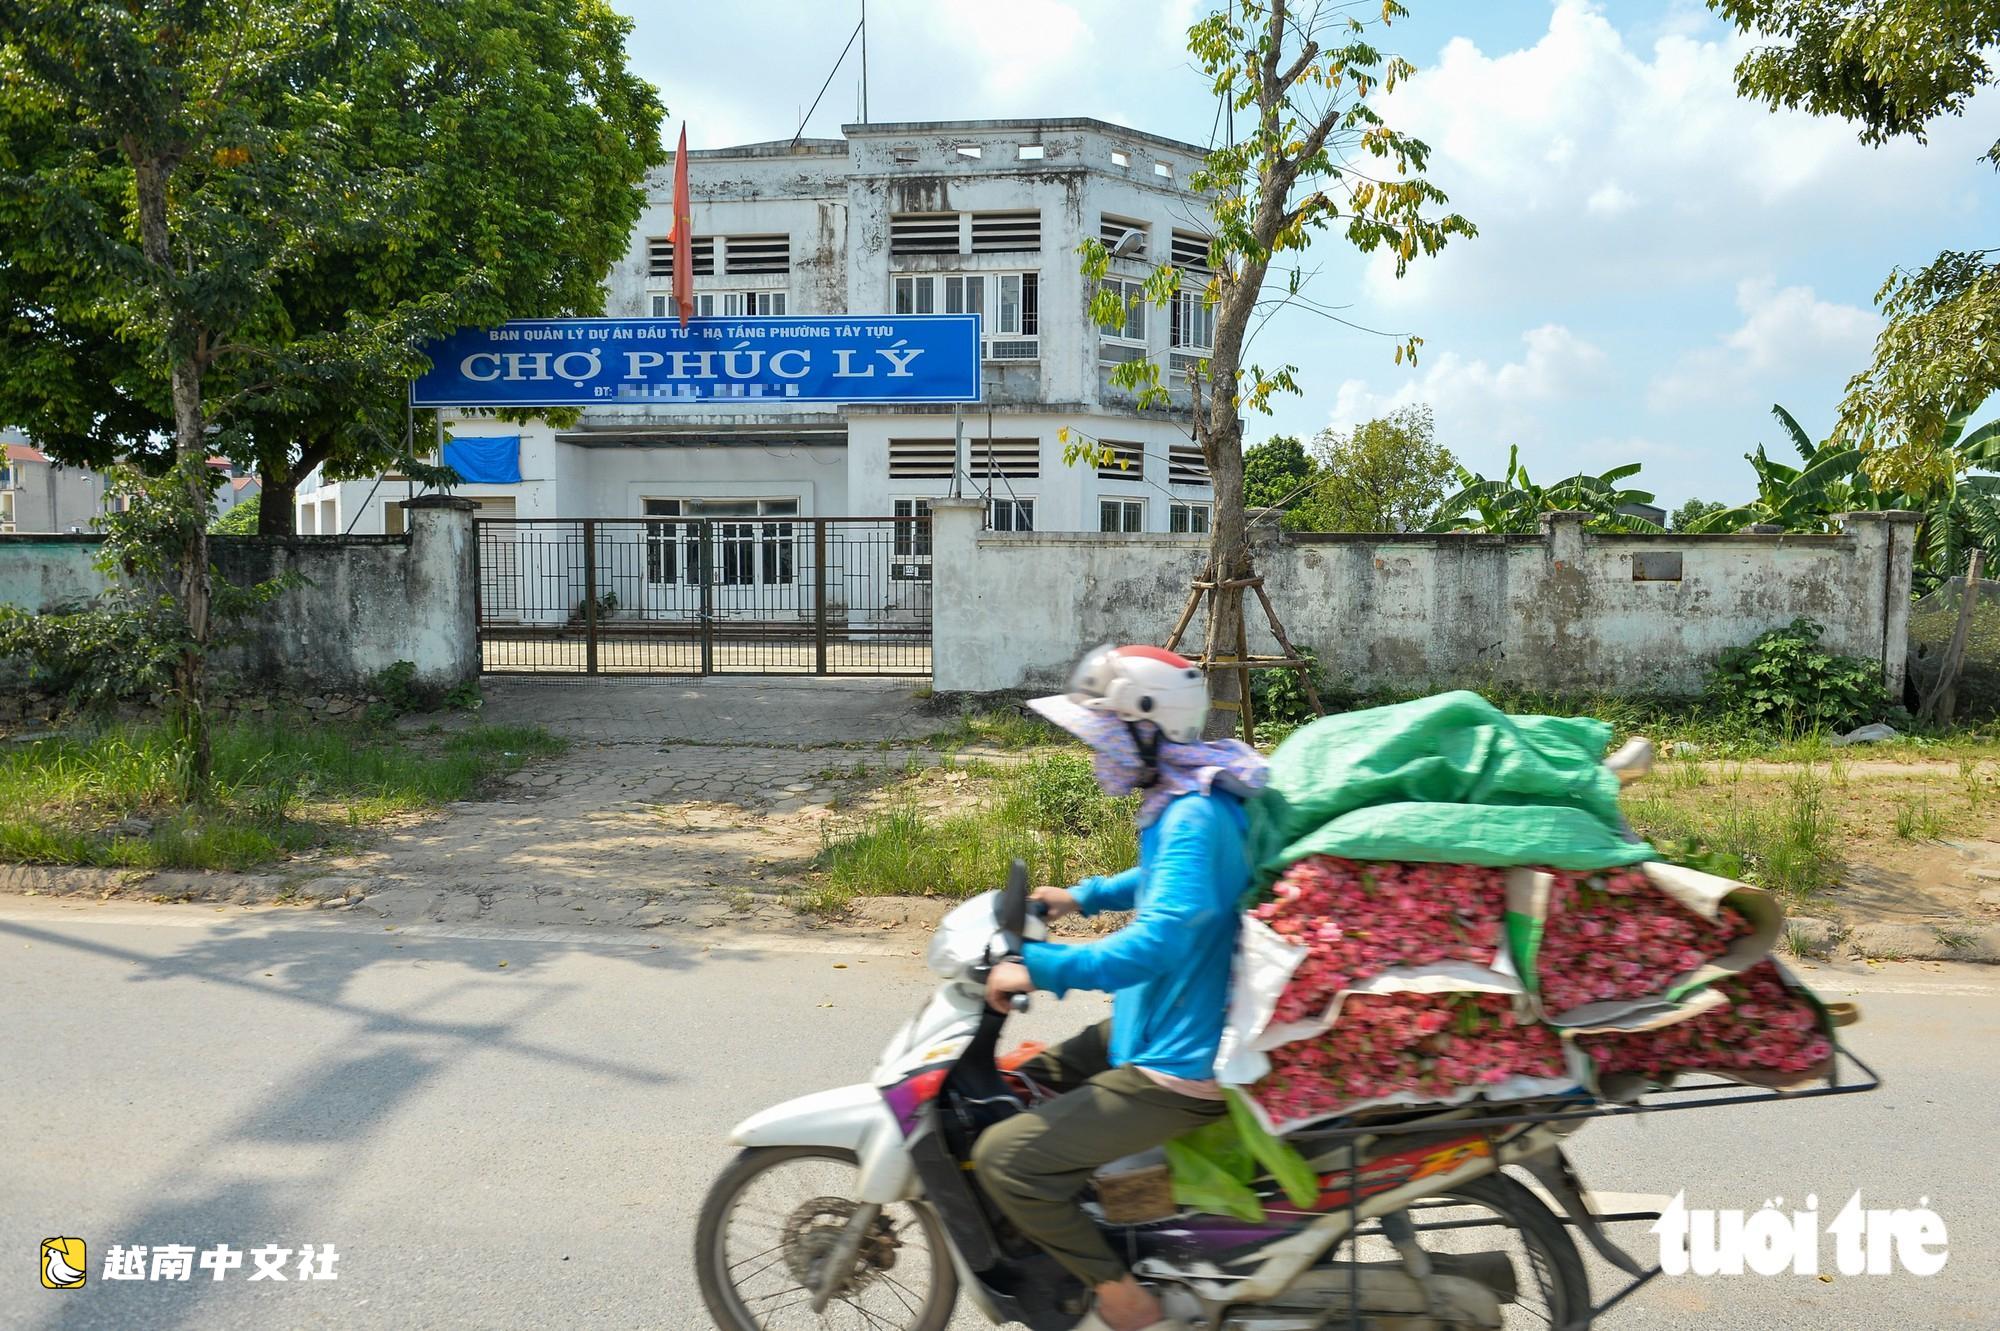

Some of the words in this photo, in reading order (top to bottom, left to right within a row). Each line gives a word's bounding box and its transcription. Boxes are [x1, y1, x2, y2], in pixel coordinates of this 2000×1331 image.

[489, 330, 519, 341] BAN
[524, 327, 563, 341] QUẢN
[568, 328, 584, 340] LÝ
[589, 328, 609, 342] DỰ
[612, 327, 633, 339] ÁN
[670, 327, 690, 339] TƯ
[703, 327, 723, 341] HẠ
[769, 324, 830, 338] PHƯỜNG
[834, 326, 861, 337] TÂY
[865, 325, 894, 339] TỰU
[459, 347, 602, 388] CHỢ
[623, 341, 811, 379] PHÚC
[832, 339, 925, 377] LÝ
[594, 386, 612, 397] ĐT:
